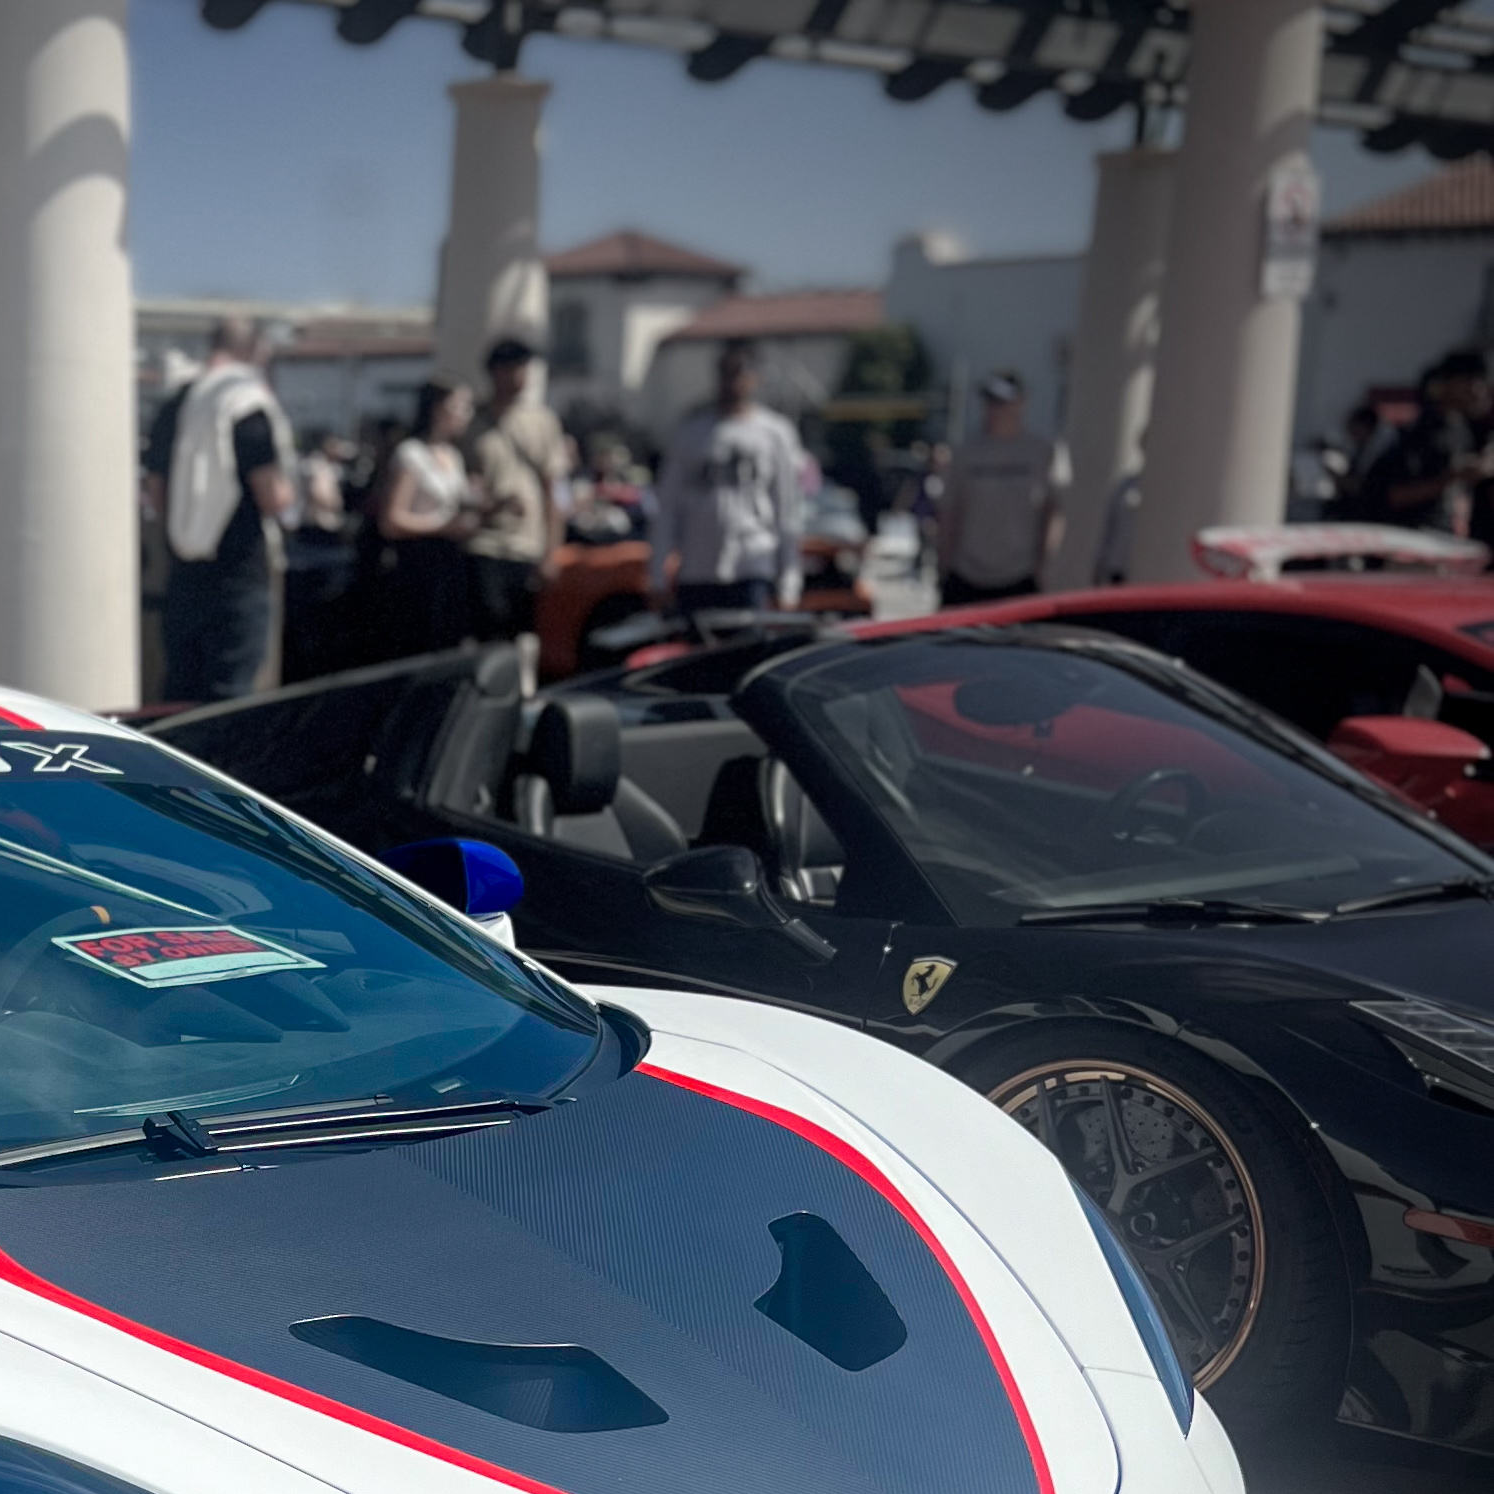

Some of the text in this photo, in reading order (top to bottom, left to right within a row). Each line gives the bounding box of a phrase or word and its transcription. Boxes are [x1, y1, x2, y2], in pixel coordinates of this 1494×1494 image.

[0, 740, 125, 775] X
[76, 931, 251, 958] FOR SALE
[112, 941, 265, 968] BY OWNER
